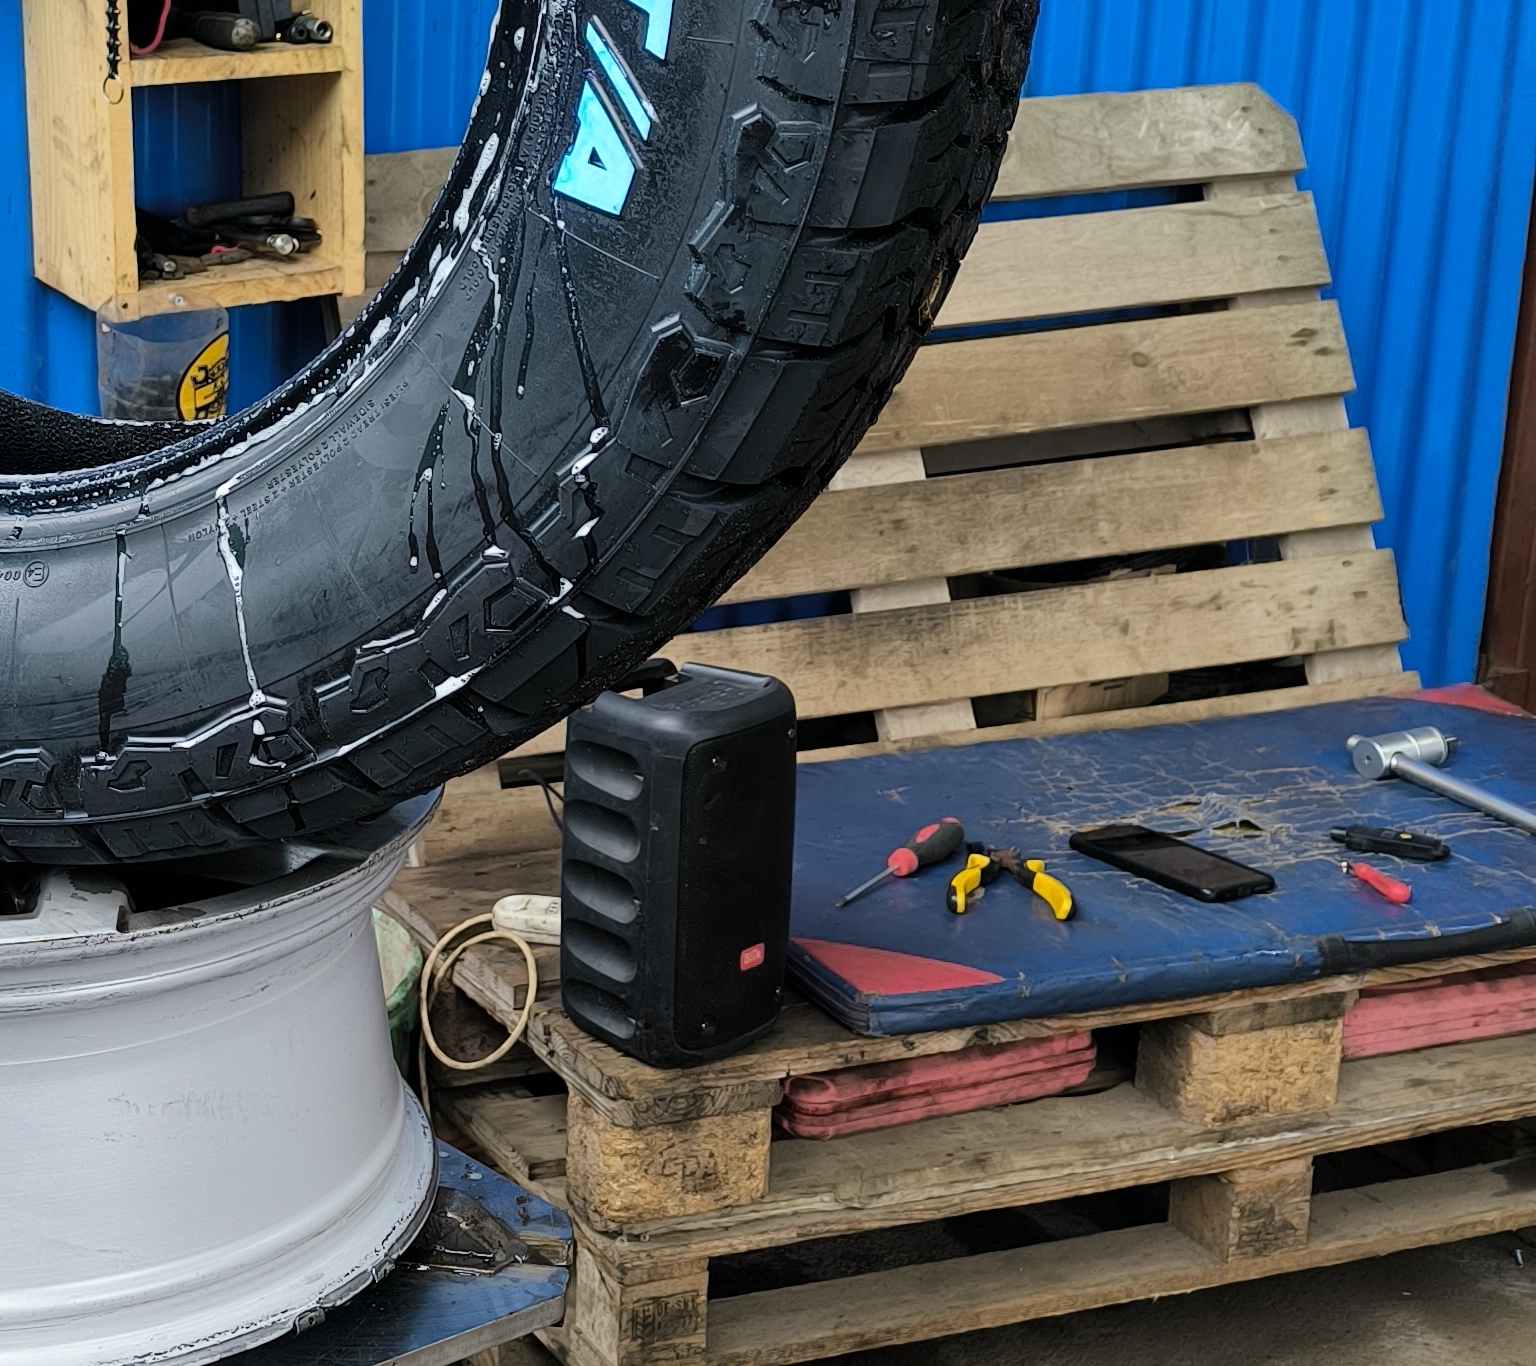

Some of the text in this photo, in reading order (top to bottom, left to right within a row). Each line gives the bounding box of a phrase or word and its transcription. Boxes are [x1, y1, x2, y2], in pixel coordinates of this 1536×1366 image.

[334, 399, 375, 439] SIDEWALL
[267, 449, 322, 490] POLYESTER
[289, 446, 342, 489] POLYESTER
[239, 496, 270, 517] STEEL
